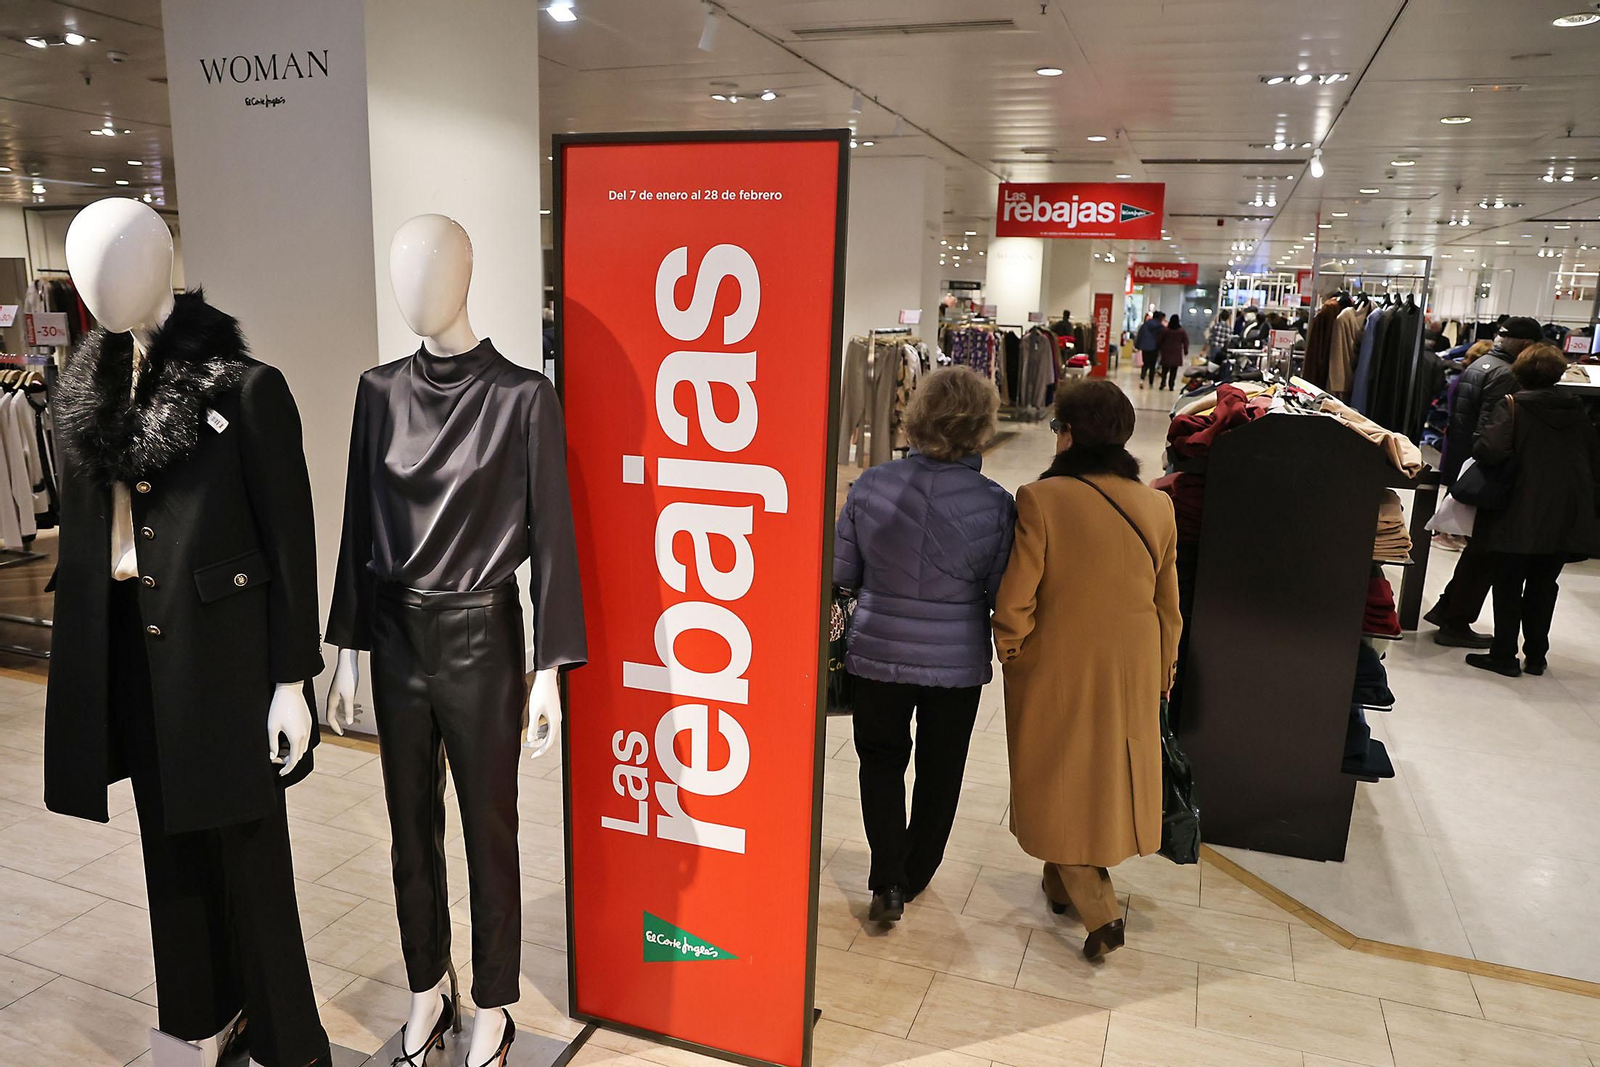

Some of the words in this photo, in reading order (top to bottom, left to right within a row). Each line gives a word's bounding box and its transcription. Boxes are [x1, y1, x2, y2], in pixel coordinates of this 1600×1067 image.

[198, 49, 329, 85] WOMAN
[608, 189, 627, 200] Del
[629, 190, 637, 200] 7
[638, 189, 653, 200] de
[655, 191, 688, 200] enero
[690, 189, 701, 200] al
[703, 189, 719, 200] 28
[721, 189, 736, 200] de
[739, 189, 783, 200] febrero
[1004, 190, 1026, 201] Las
[1003, 195, 1116, 229] rebajas
[1134, 266, 1179, 280] rebajas
[37, 326, 66, 337] -30%
[1096, 307, 1109, 353] rebajas
[622, 243, 789, 855] rebajas
[601, 729, 649, 836] Las
[646, 931, 657, 943] El
[656, 934, 682, 949] Corte
[681, 936, 719, 958] Inglés
